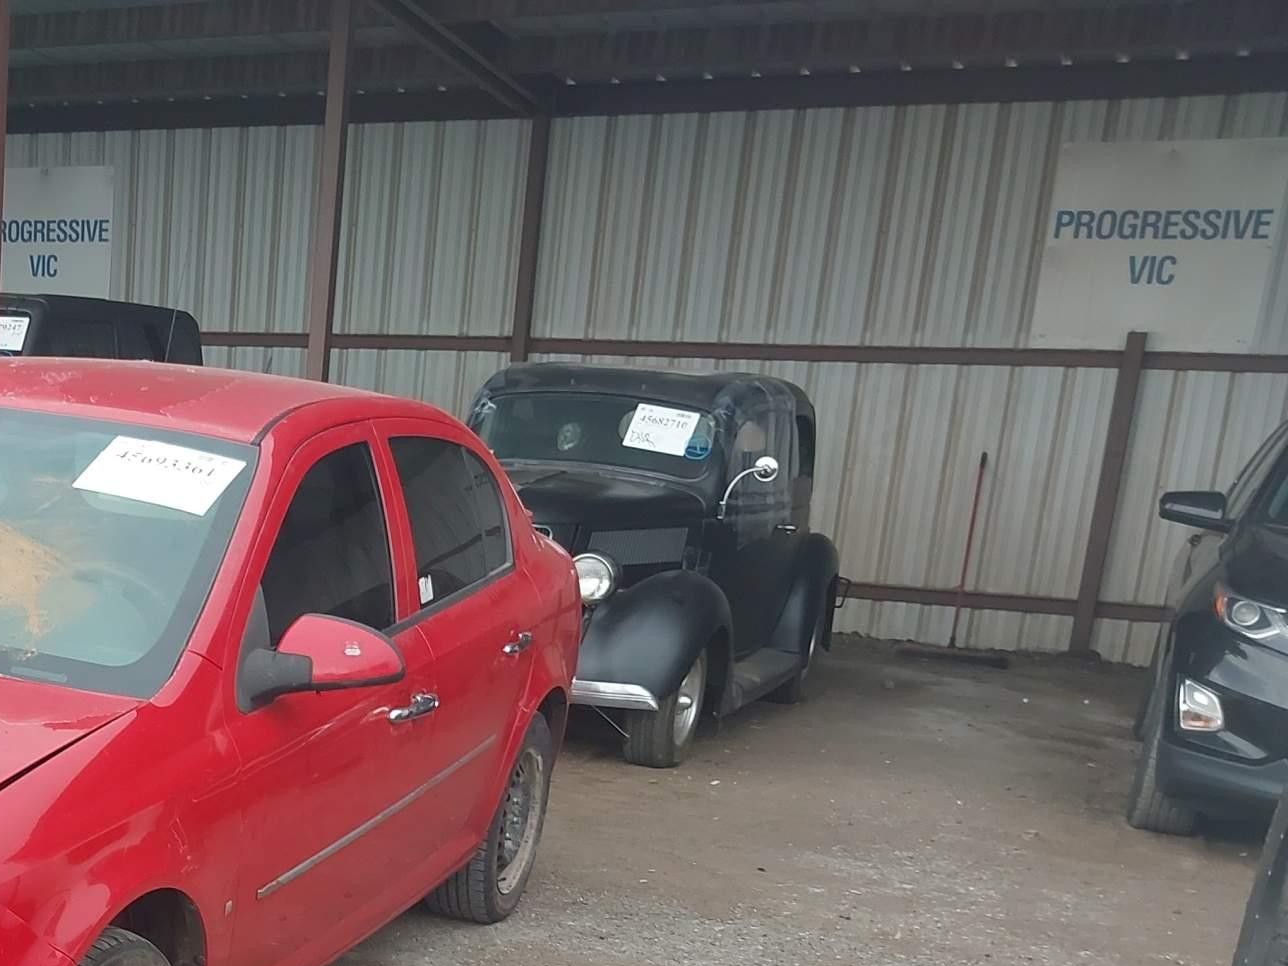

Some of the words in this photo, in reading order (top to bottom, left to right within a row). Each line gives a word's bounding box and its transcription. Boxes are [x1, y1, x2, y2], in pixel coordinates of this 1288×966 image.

[0, 219, 110, 243] ROGRESSIVE
[1053, 209, 1275, 240] PROGRESSIVE
[29, 254, 58, 277] VIC
[1129, 255, 1177, 285] VIC
